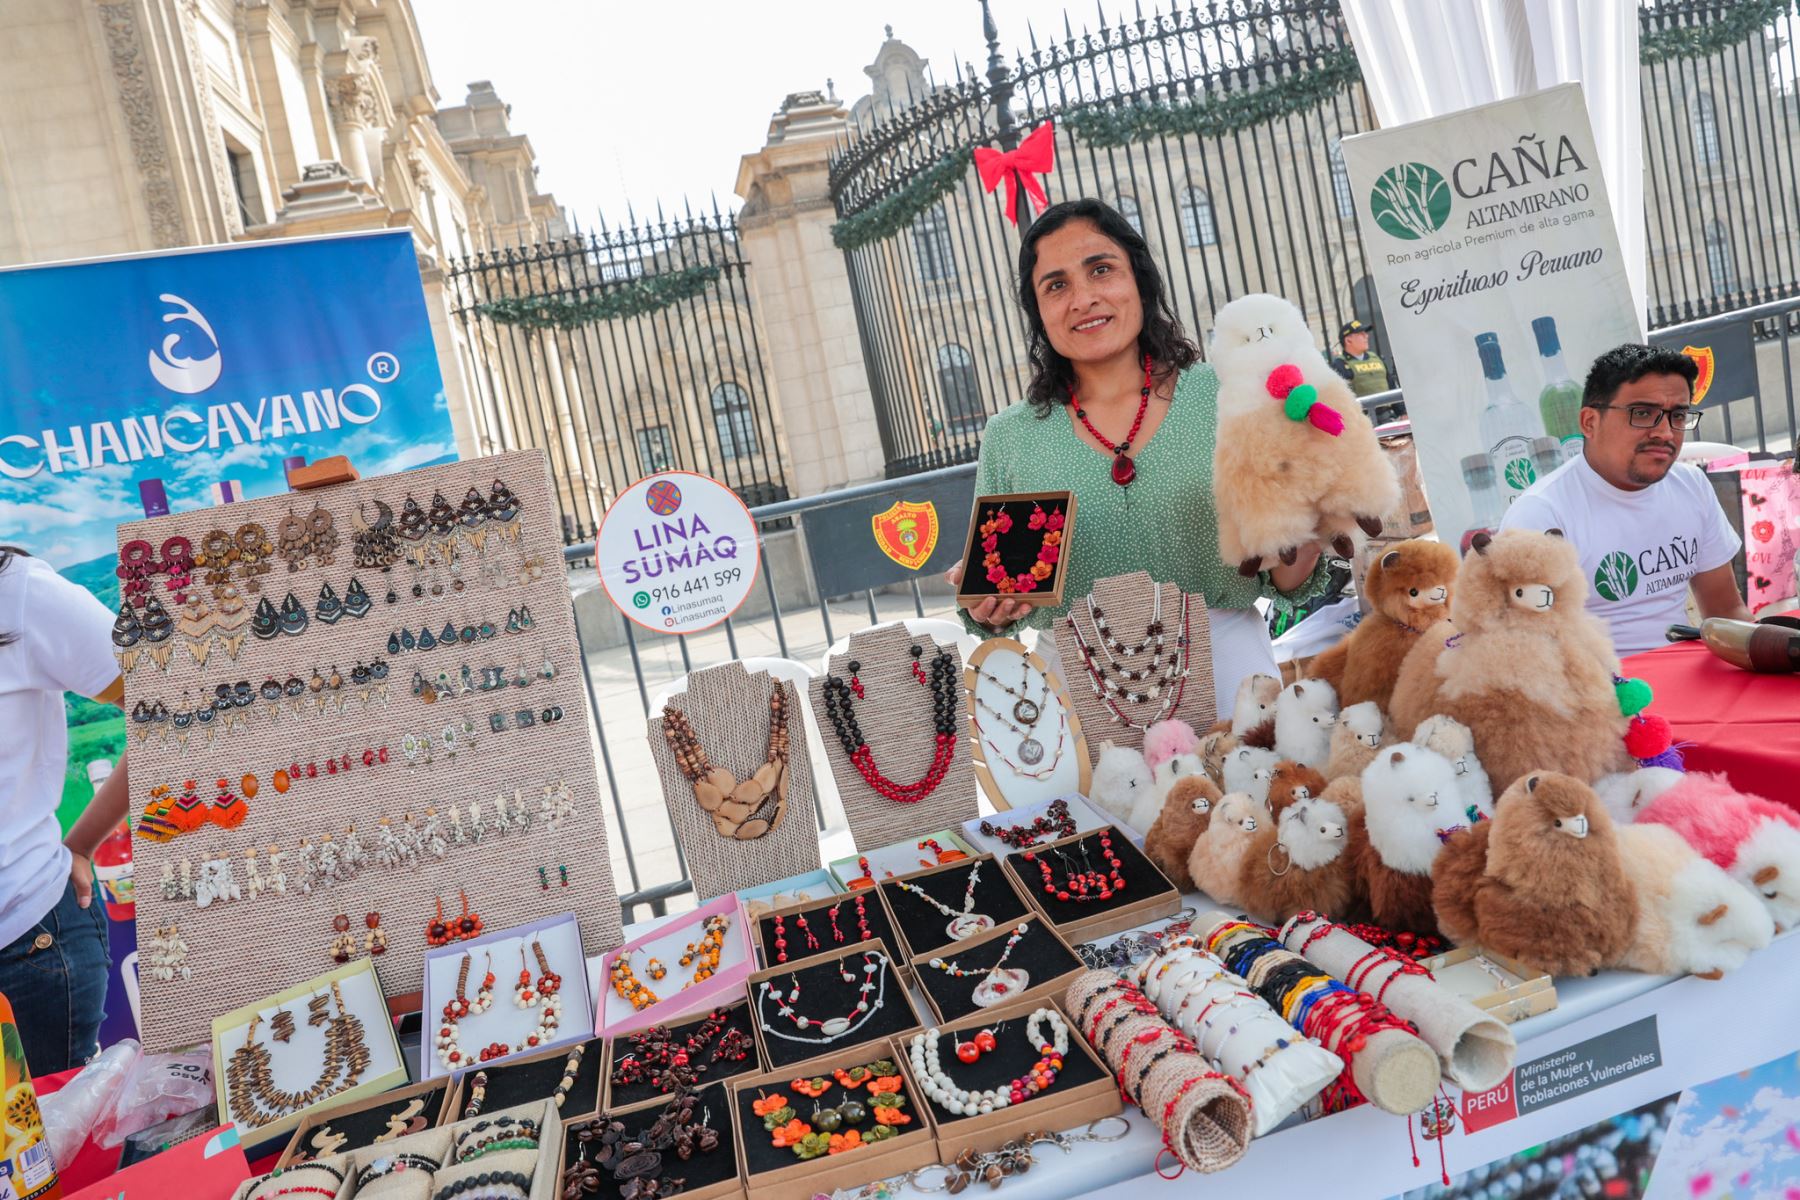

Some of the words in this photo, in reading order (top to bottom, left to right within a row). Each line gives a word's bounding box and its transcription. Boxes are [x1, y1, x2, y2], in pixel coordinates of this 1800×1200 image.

[1452, 132, 1589, 200] CAÑA
[1466, 183, 1590, 230] ALTAMIRANO
[1387, 253, 1411, 266] Ron
[1464, 228, 1516, 247] Premium
[1519, 221, 1535, 234] de
[1538, 216, 1560, 230] alta
[1562, 209, 1595, 226] gama
[1399, 269, 1509, 315] Espirituoso
[1516, 247, 1603, 282] Peruano
[0, 383, 381, 479] CHANCAYANO
[634, 512, 711, 551] LINA
[1638, 535, 1698, 576] CAÑA
[652, 584, 680, 603] 916
[683, 575, 710, 595] 441
[714, 567, 741, 587] 599
[671, 593, 724, 614] Linasumaq
[674, 605, 727, 625] Linasumaq
[1520, 1051, 1577, 1079] Ministerio
[1520, 1079, 1536, 1092] de
[1537, 1075, 1549, 1087] la
[1550, 1064, 1583, 1085] Mujer
[1586, 1059, 1594, 1071] y
[1522, 1076, 1590, 1107] Poblaciones
[1590, 1052, 1656, 1083] Vulnerables
[1467, 1084, 1509, 1114] PERÚ
